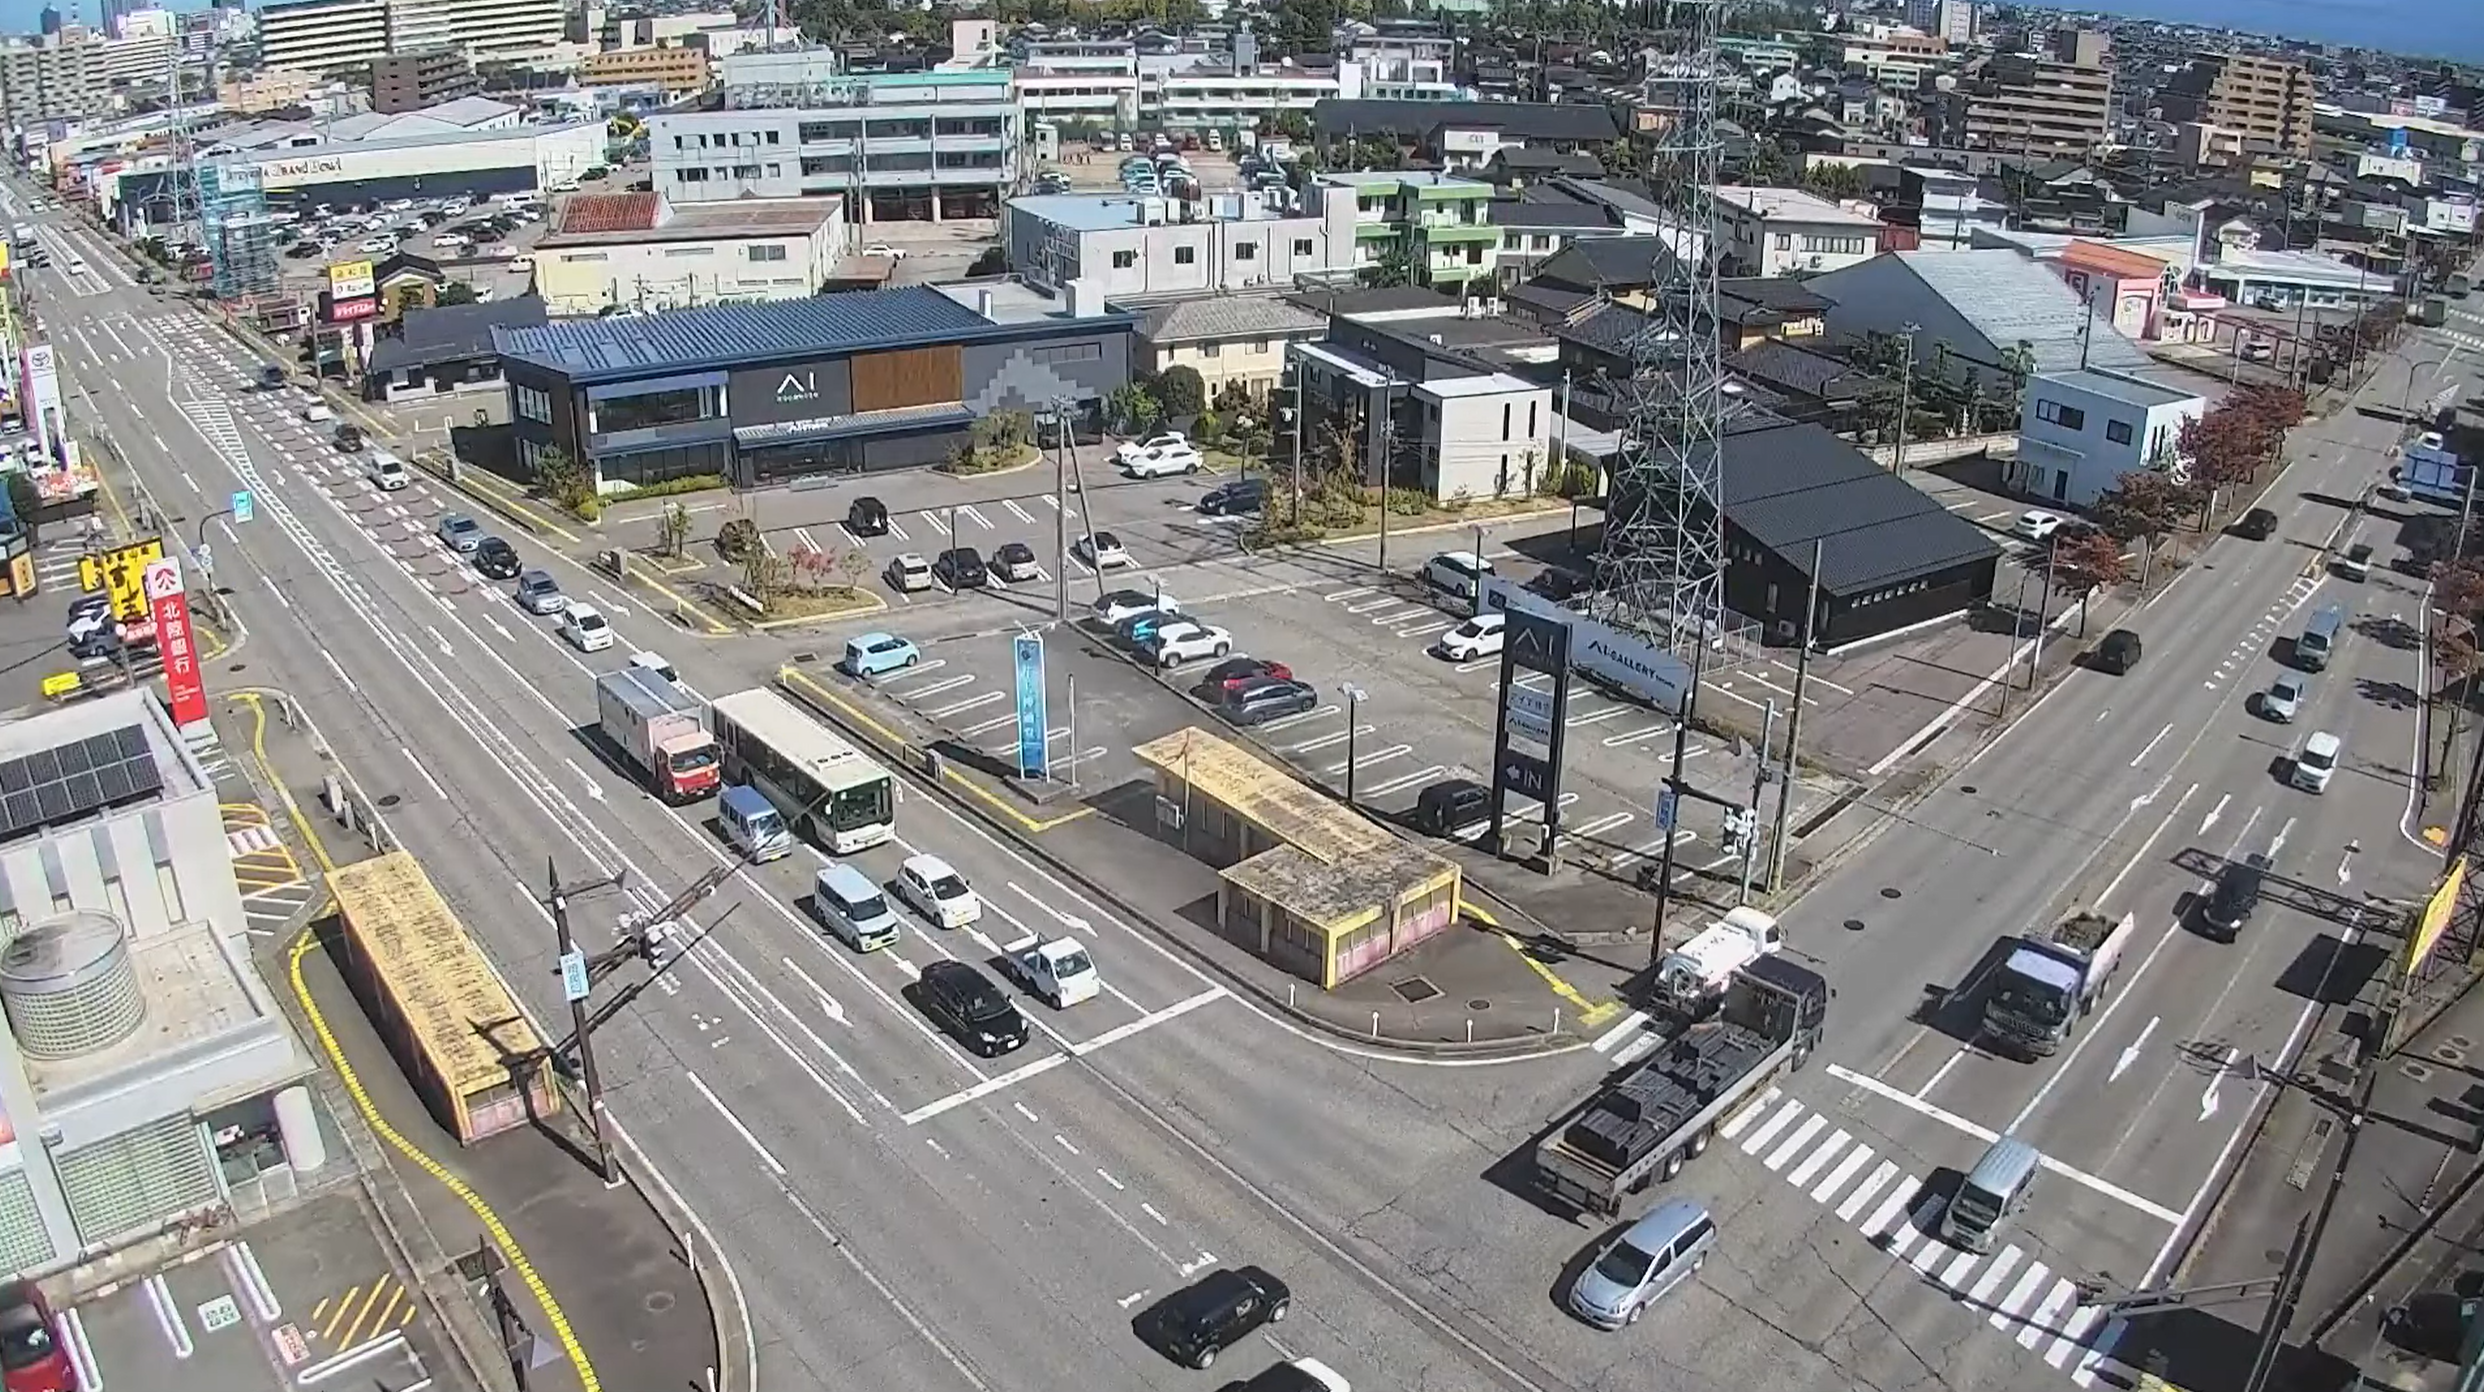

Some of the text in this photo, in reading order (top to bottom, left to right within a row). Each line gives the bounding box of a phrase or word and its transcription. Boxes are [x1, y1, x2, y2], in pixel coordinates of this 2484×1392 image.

[162, 601, 190, 675] 北陸銀行
[1522, 768, 1543, 791] IN
